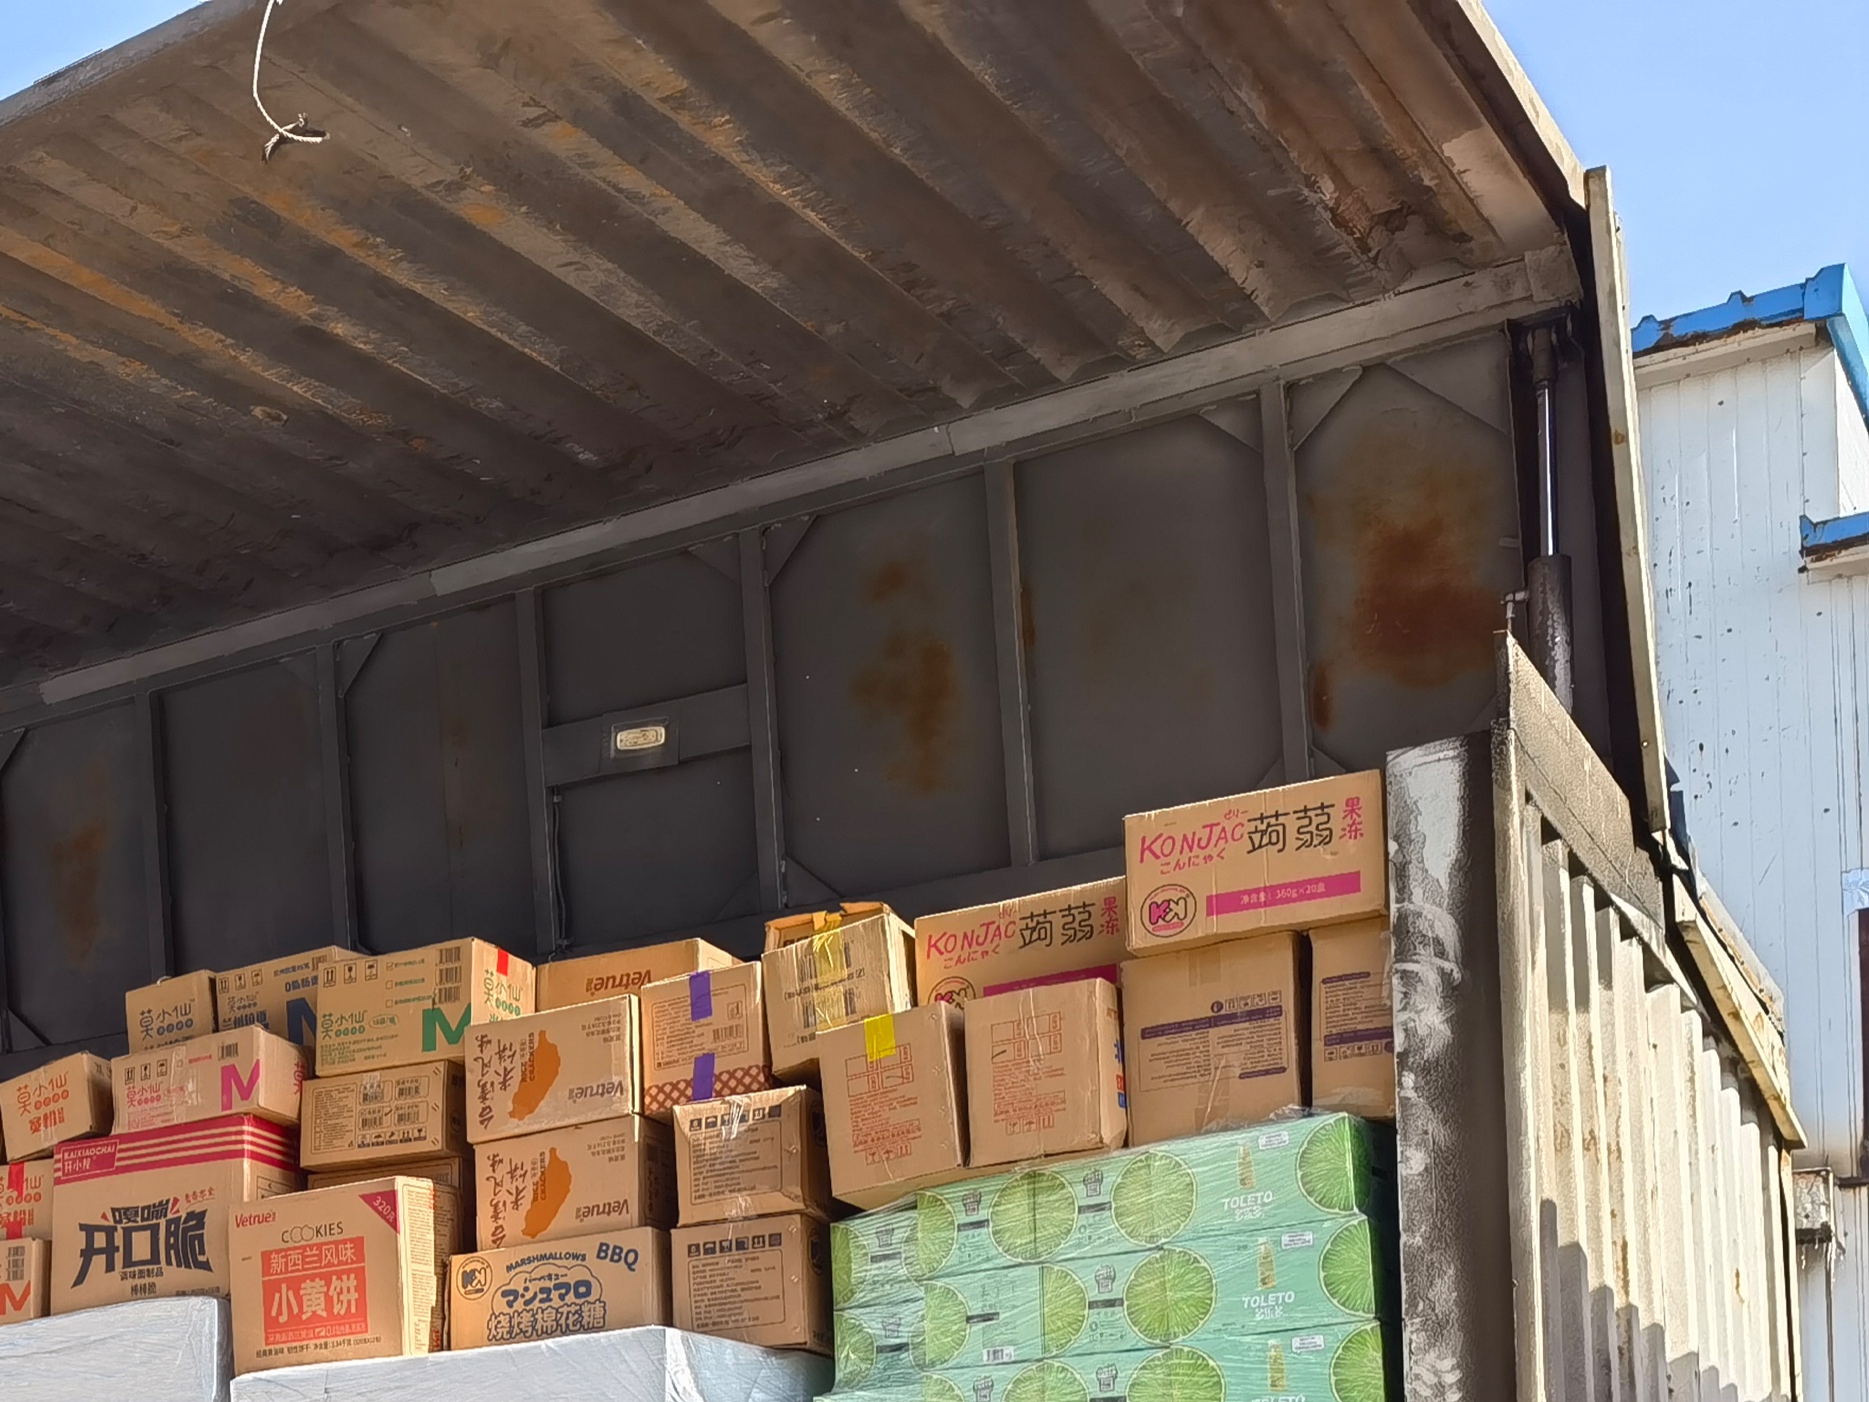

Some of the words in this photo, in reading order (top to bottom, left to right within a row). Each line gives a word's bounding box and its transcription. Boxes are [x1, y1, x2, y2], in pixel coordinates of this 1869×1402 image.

[1139, 821, 1246, 864] KONJAC
[1246, 802, 1336, 855] 蒟蒻
[1338, 796, 1365, 841] 果冻
[1159, 847, 1226, 876] こんにゃく
[926, 920, 1017, 960] KONJAC
[1018, 901, 1097, 950] 蒟蒻
[1097, 896, 1121, 936] 果冻
[138, 1001, 193, 1041] 莫小仙
[320, 1009, 369, 1041] 莫小仙
[16, 1073, 69, 1117] 莫小仙
[576, 1079, 624, 1100] Vetrue
[580, 1198, 630, 1220] Vetrue
[1220, 1190, 1274, 1212] TOLETO
[234, 1212, 272, 1229] Vetrue
[280, 1221, 345, 1244] COOKIES
[70, 1208, 214, 1290] 开口脆
[268, 1240, 358, 1275] 新西兰风味
[505, 1251, 587, 1274] MARSHMALLOWS
[595, 1241, 640, 1273] BBQ
[270, 1272, 360, 1325] 小黄饼
[500, 1279, 593, 1309] マシュマロ
[1241, 1290, 1296, 1309] TOLETO
[486, 1298, 608, 1342] 烧烤棉花糖
